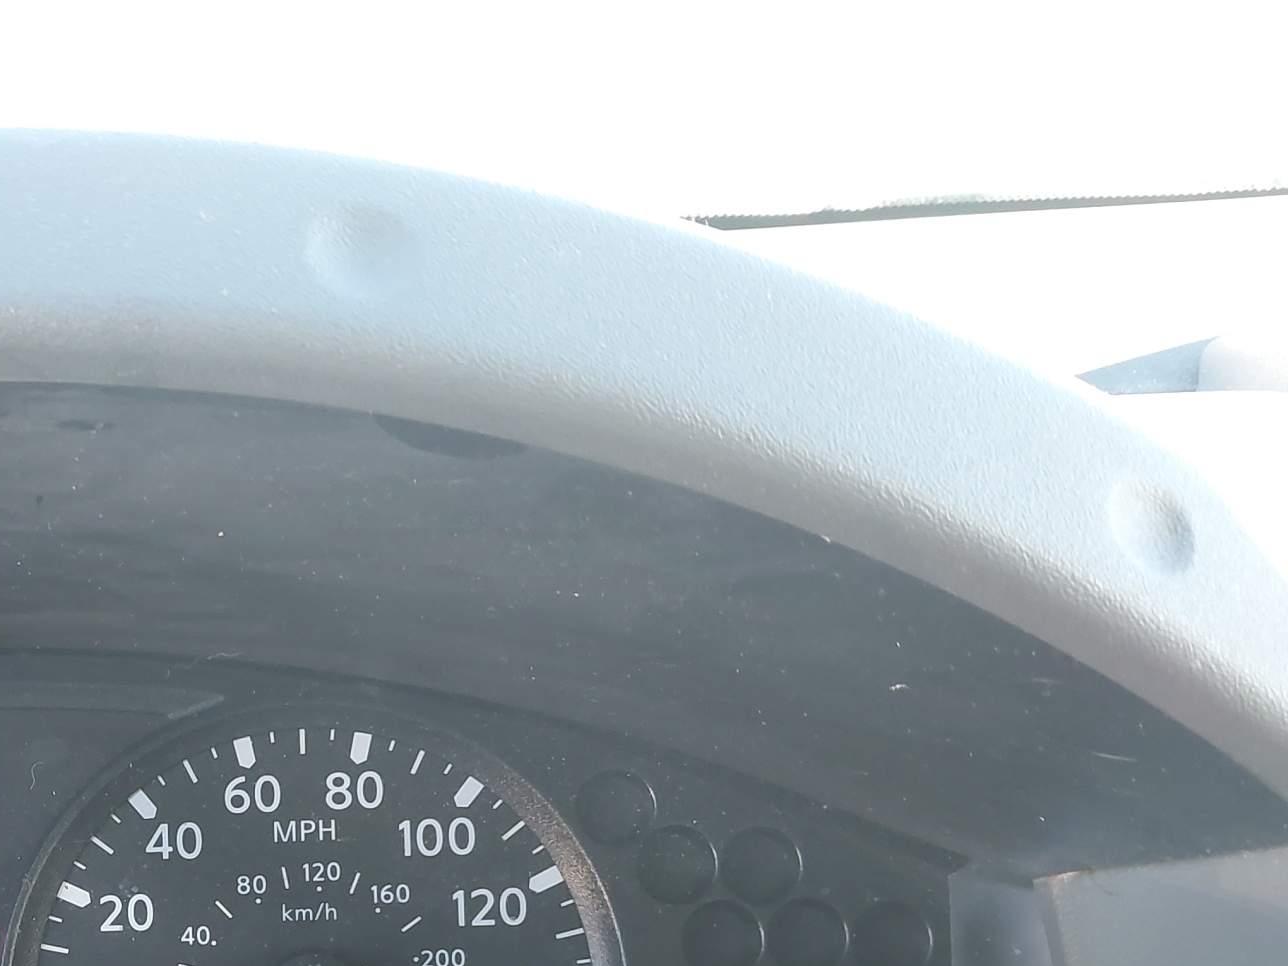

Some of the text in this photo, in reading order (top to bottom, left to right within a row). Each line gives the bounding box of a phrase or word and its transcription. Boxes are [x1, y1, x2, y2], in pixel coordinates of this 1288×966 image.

[224, 775, 281, 814] 60
[325, 770, 384, 810] 80
[145, 821, 203, 860] 40
[273, 819, 336, 843] MPH
[398, 817, 476, 857] 100
[237, 875, 267, 895] 80
[302, 861, 341, 882] 120
[370, 883, 410, 904] 160
[452, 887, 527, 927] 120
[99, 893, 154, 932] 20
[282, 902, 337, 922] km/h
[180, 925, 212, 947] 40
